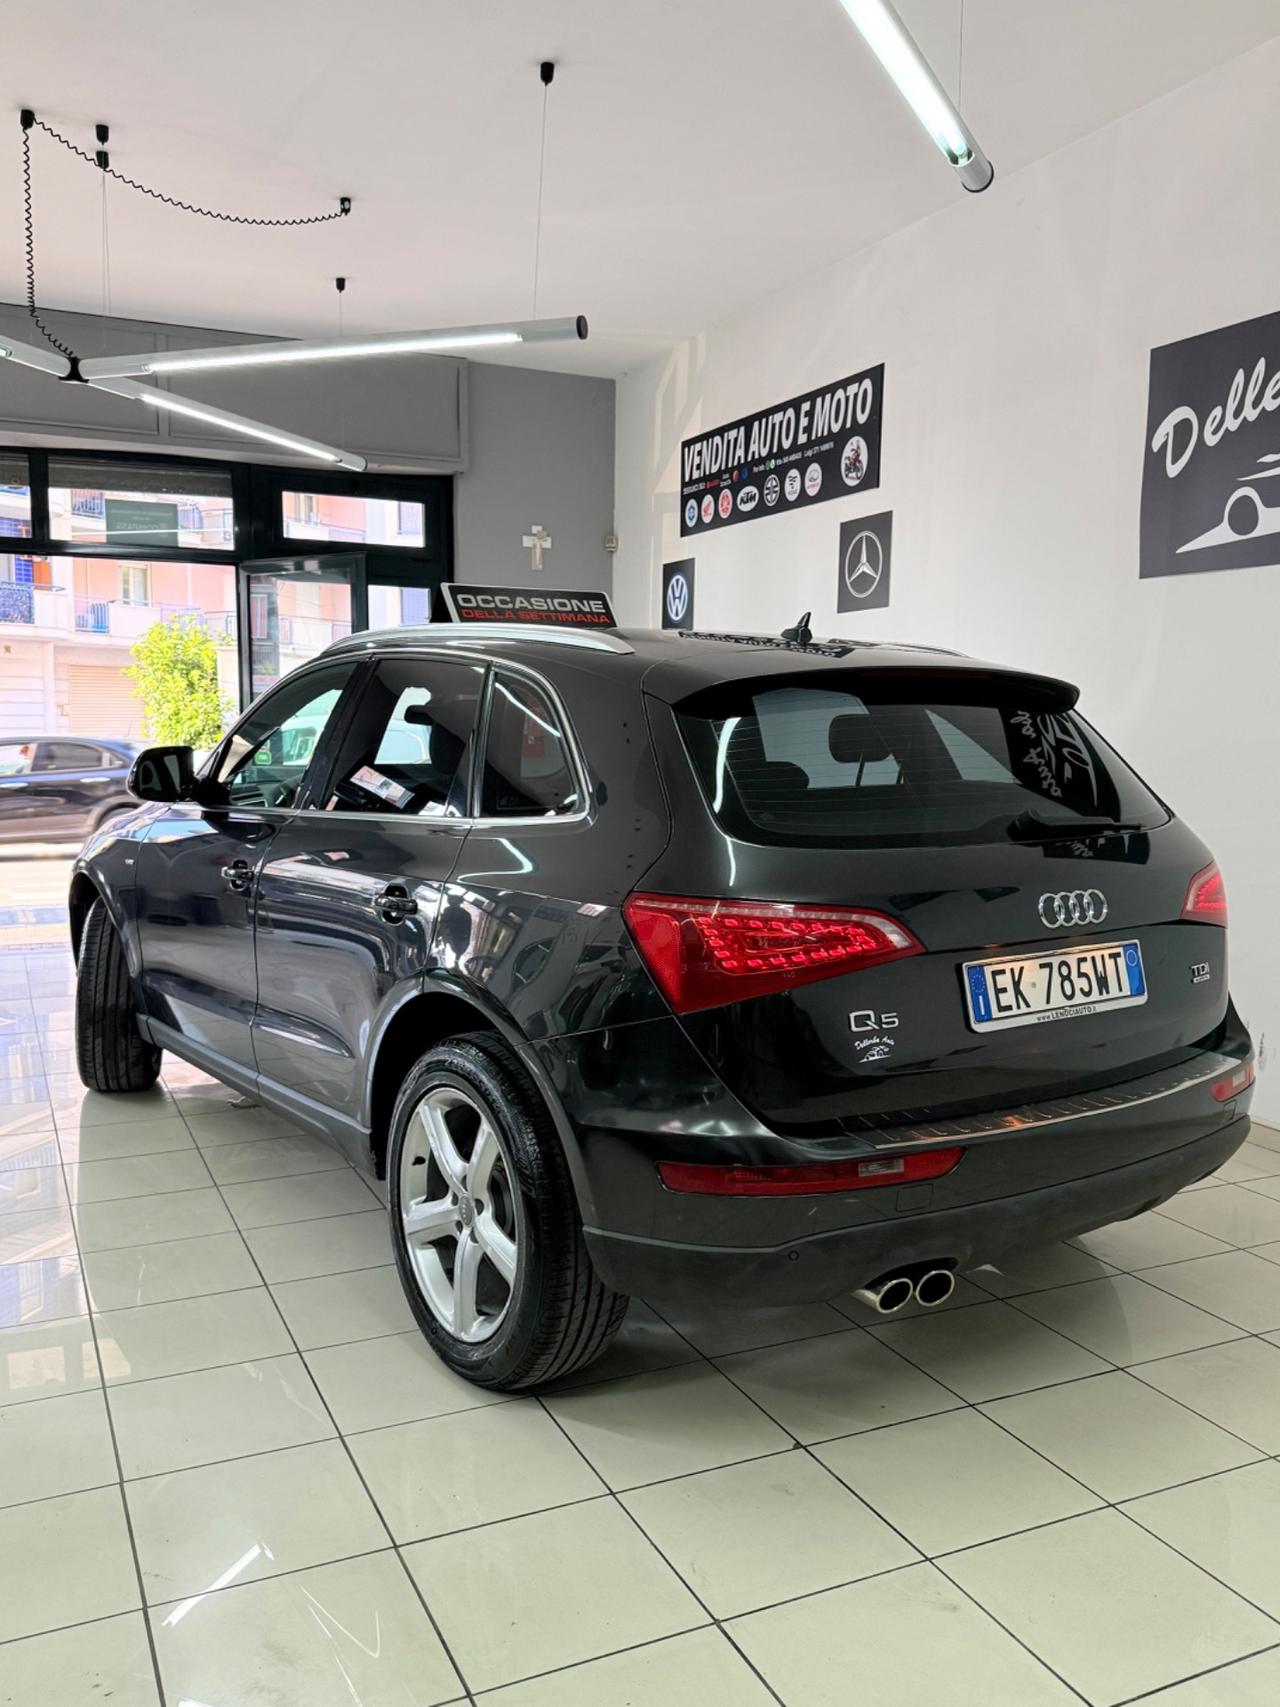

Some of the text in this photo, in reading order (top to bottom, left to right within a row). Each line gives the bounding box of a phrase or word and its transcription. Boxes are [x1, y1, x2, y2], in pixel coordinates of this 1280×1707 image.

[684, 377, 873, 482] VENDITA AUTO E MOTO
[740, 490, 757, 506] KTM
[456, 594, 606, 613] OCCASIONE
[461, 608, 611, 624] DELLA SETTIMANA
[1191, 961, 1210, 977] TDI
[991, 952, 1124, 1013] EK 785WT
[849, 1009, 899, 1032] Q5
